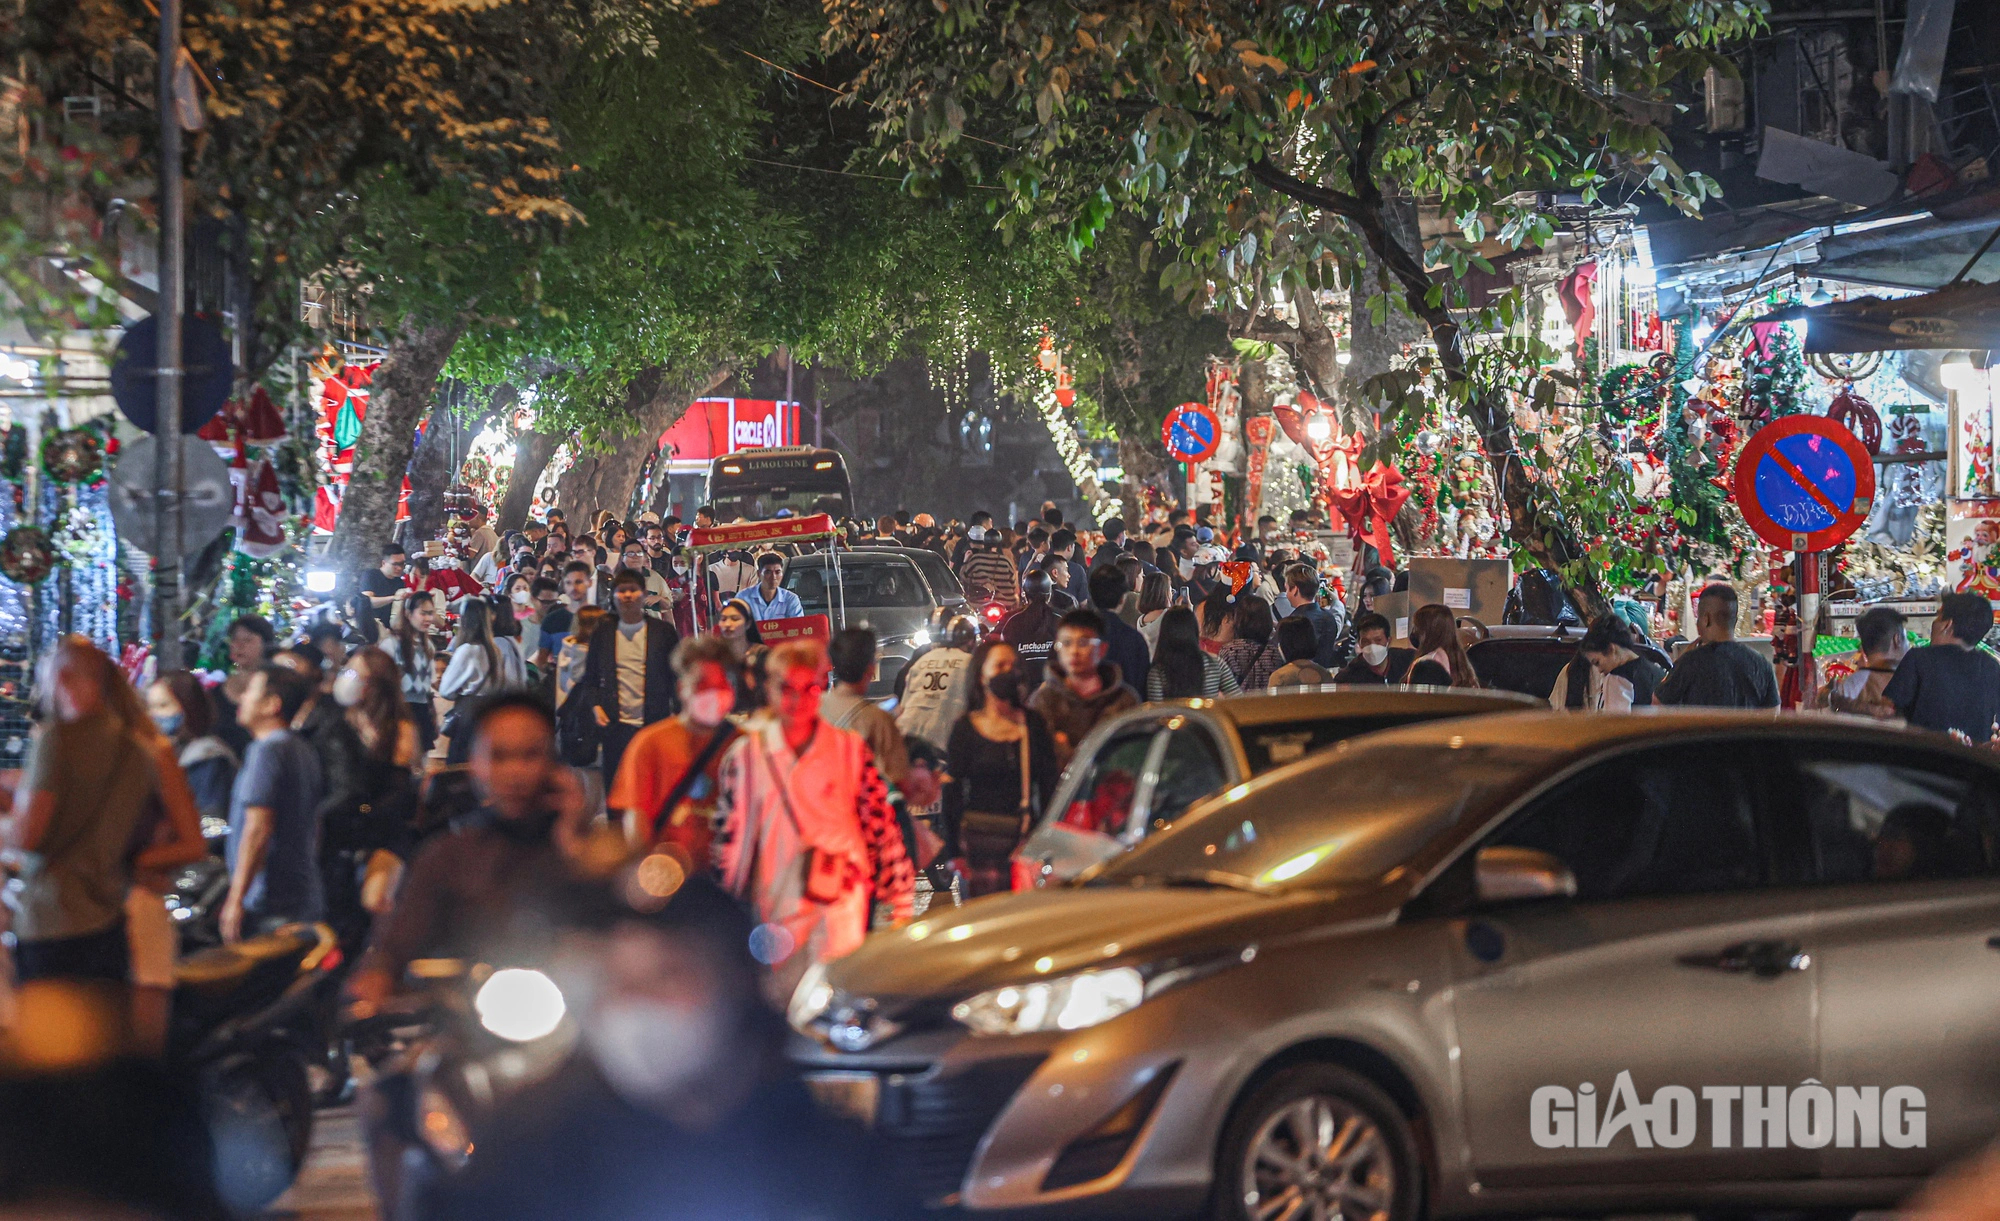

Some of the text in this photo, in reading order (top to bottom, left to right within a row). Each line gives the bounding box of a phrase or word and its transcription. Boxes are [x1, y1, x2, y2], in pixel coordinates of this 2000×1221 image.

[735, 420, 763, 445] CIRCLE
[749, 460, 808, 469] LIMOUSINE
[792, 524, 802, 532] 40
[802, 626, 813, 635] 40
[919, 658, 963, 670] CELINE
